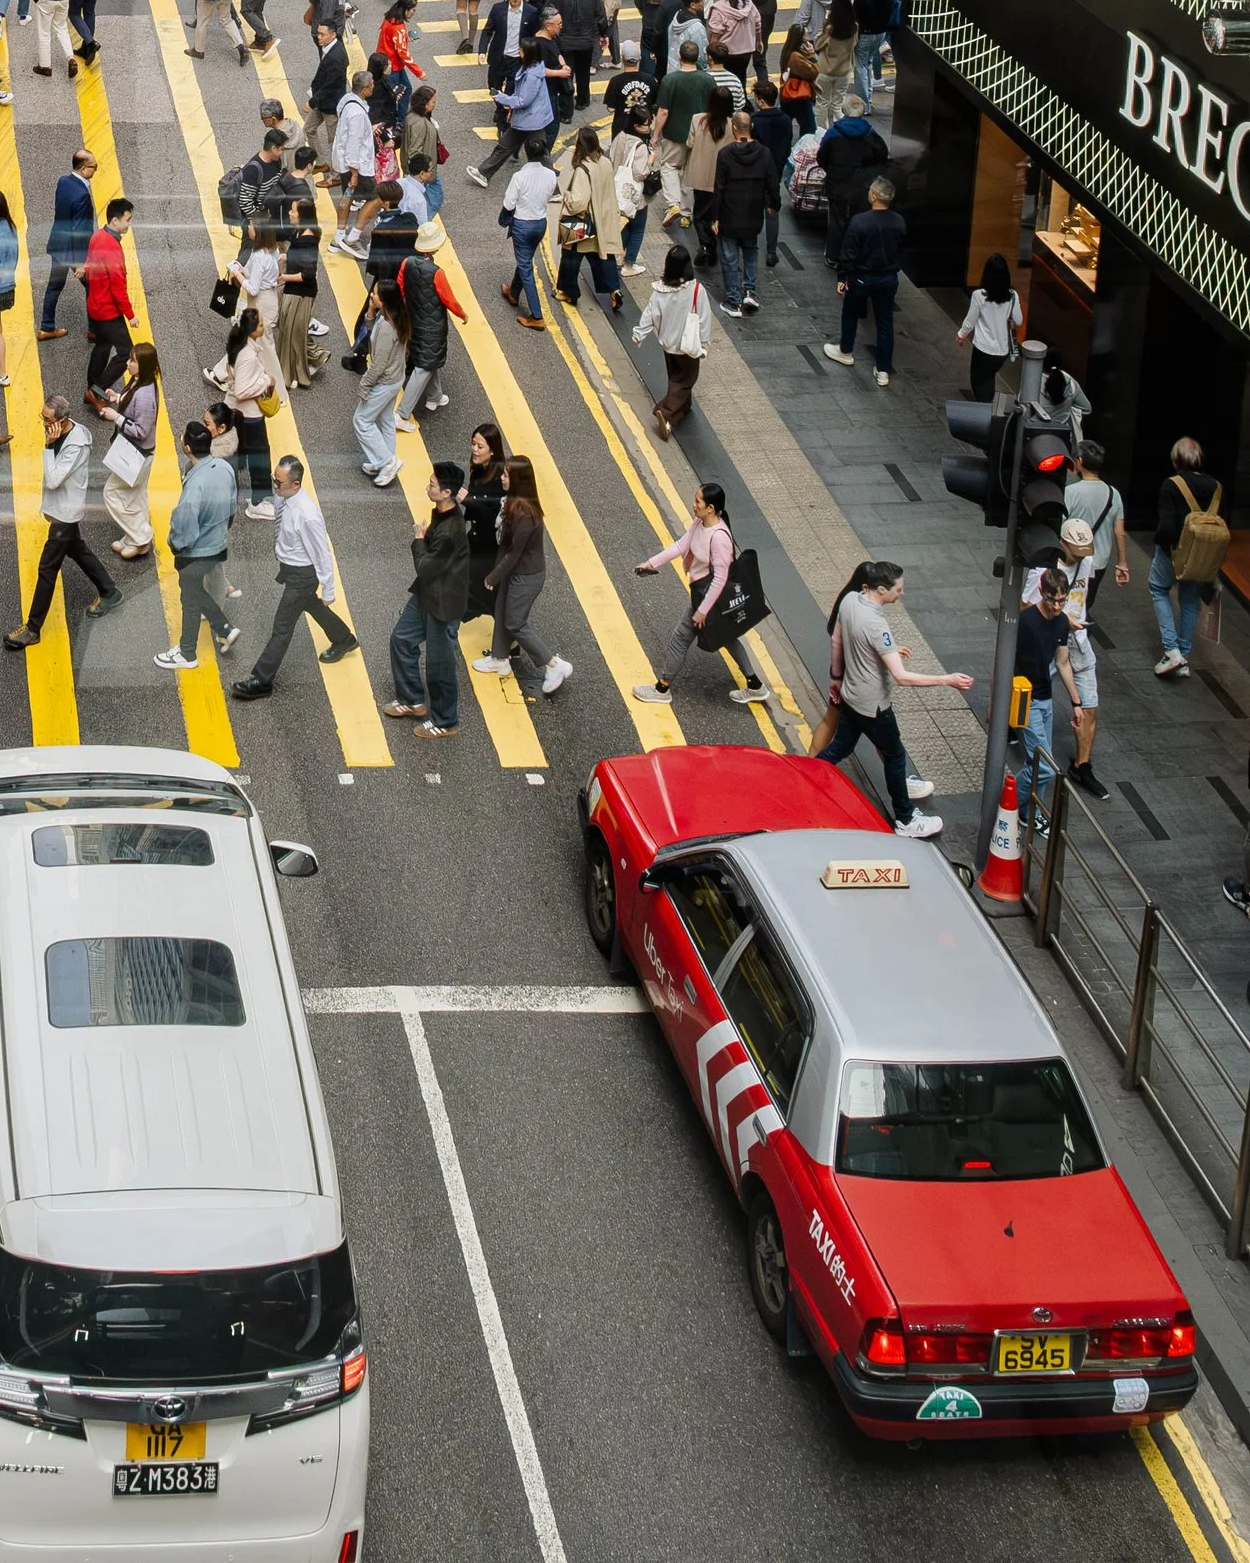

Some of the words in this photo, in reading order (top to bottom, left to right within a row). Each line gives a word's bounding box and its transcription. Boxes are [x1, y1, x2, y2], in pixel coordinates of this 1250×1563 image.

[882, 632, 892, 647] 3
[837, 868, 901, 883] TAXI
[643, 923, 666, 985] Uber
[808, 1208, 837, 1267] TAXI
[831, 1254, 857, 1306] 的士
[1003, 1349, 1065, 1370] 6945
[940, 1391, 965, 1401] TAXI
[946, 1401, 958, 1412] 4
[147, 1436, 185, 1458] 1117
